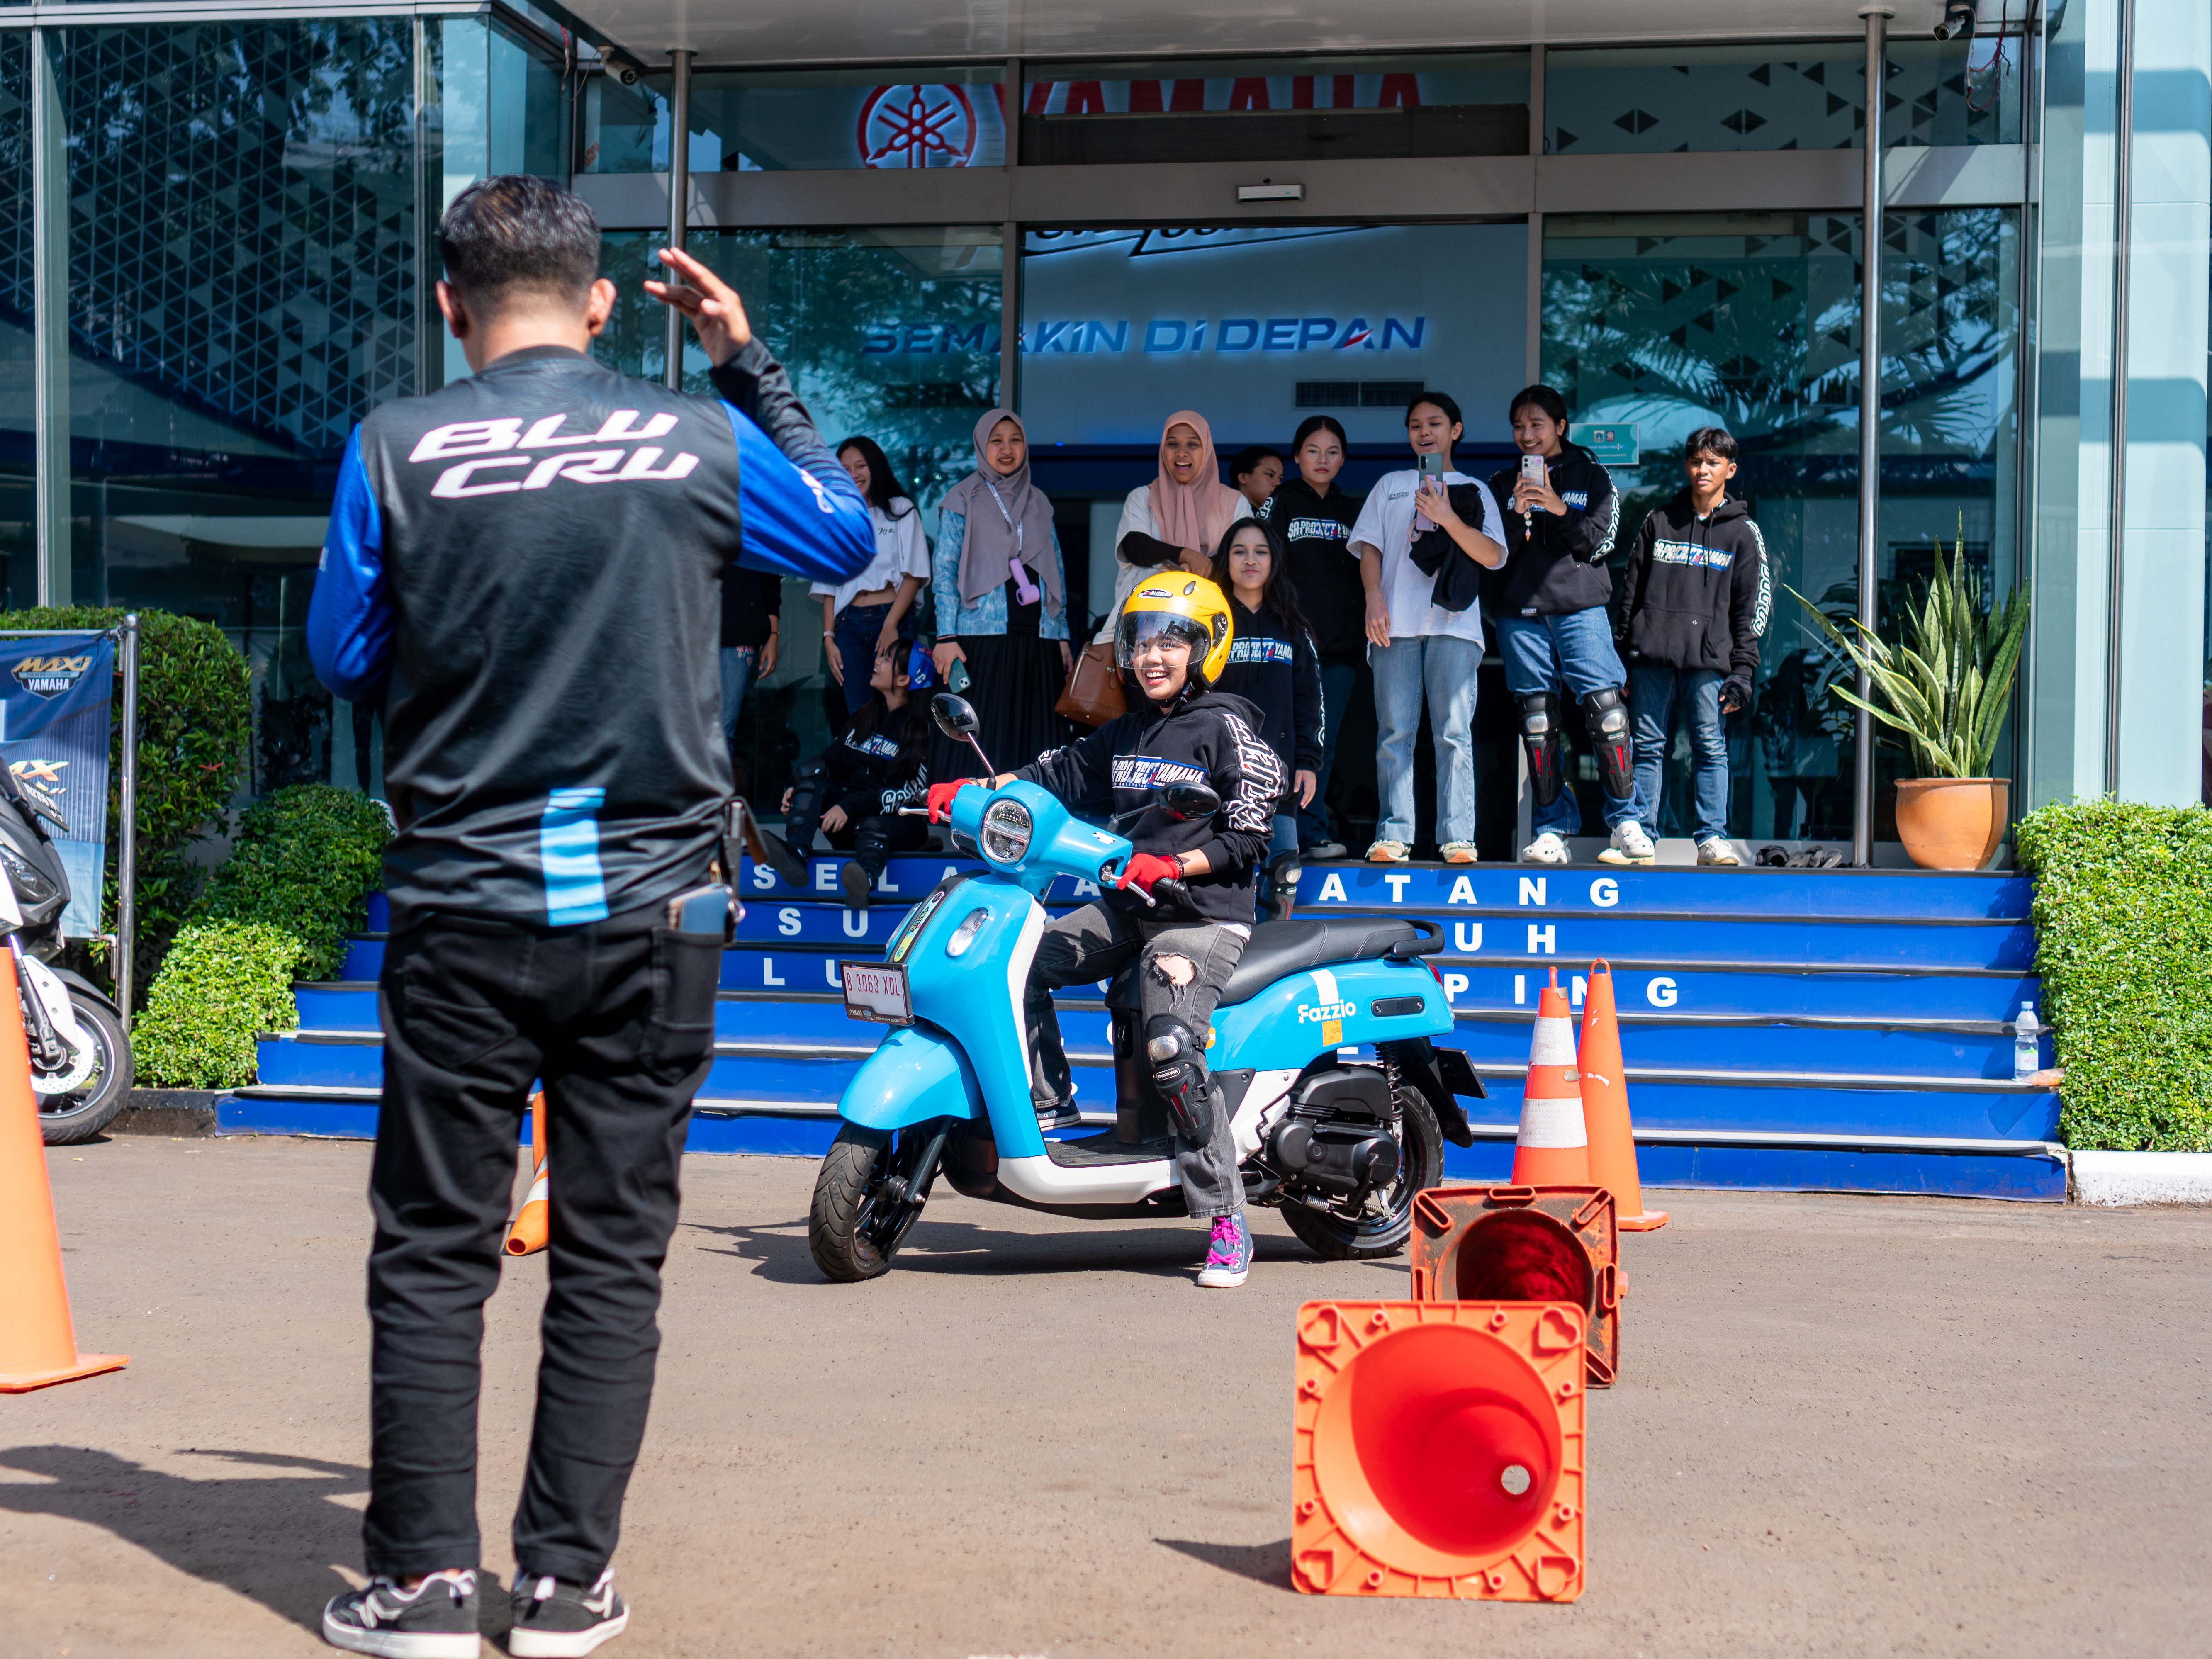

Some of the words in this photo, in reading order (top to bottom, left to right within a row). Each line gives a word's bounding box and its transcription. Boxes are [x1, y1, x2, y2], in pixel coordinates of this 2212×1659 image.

[1144, 319, 1207, 352] DI
[1216, 316, 1426, 351] DEPAN
[409, 409, 679, 462] BLU
[430, 447, 700, 498] CRU
[13, 656, 92, 673] MAXI
[27, 678, 69, 691] YAMAHA
[1155, 762, 1205, 784] YAMAHA
[1318, 873, 1619, 907] ATANG
[846, 973, 853, 991] B
[856, 973, 879, 994] 3063
[883, 975, 900, 996] XDL
[1297, 998, 1356, 1024] Fazzio
